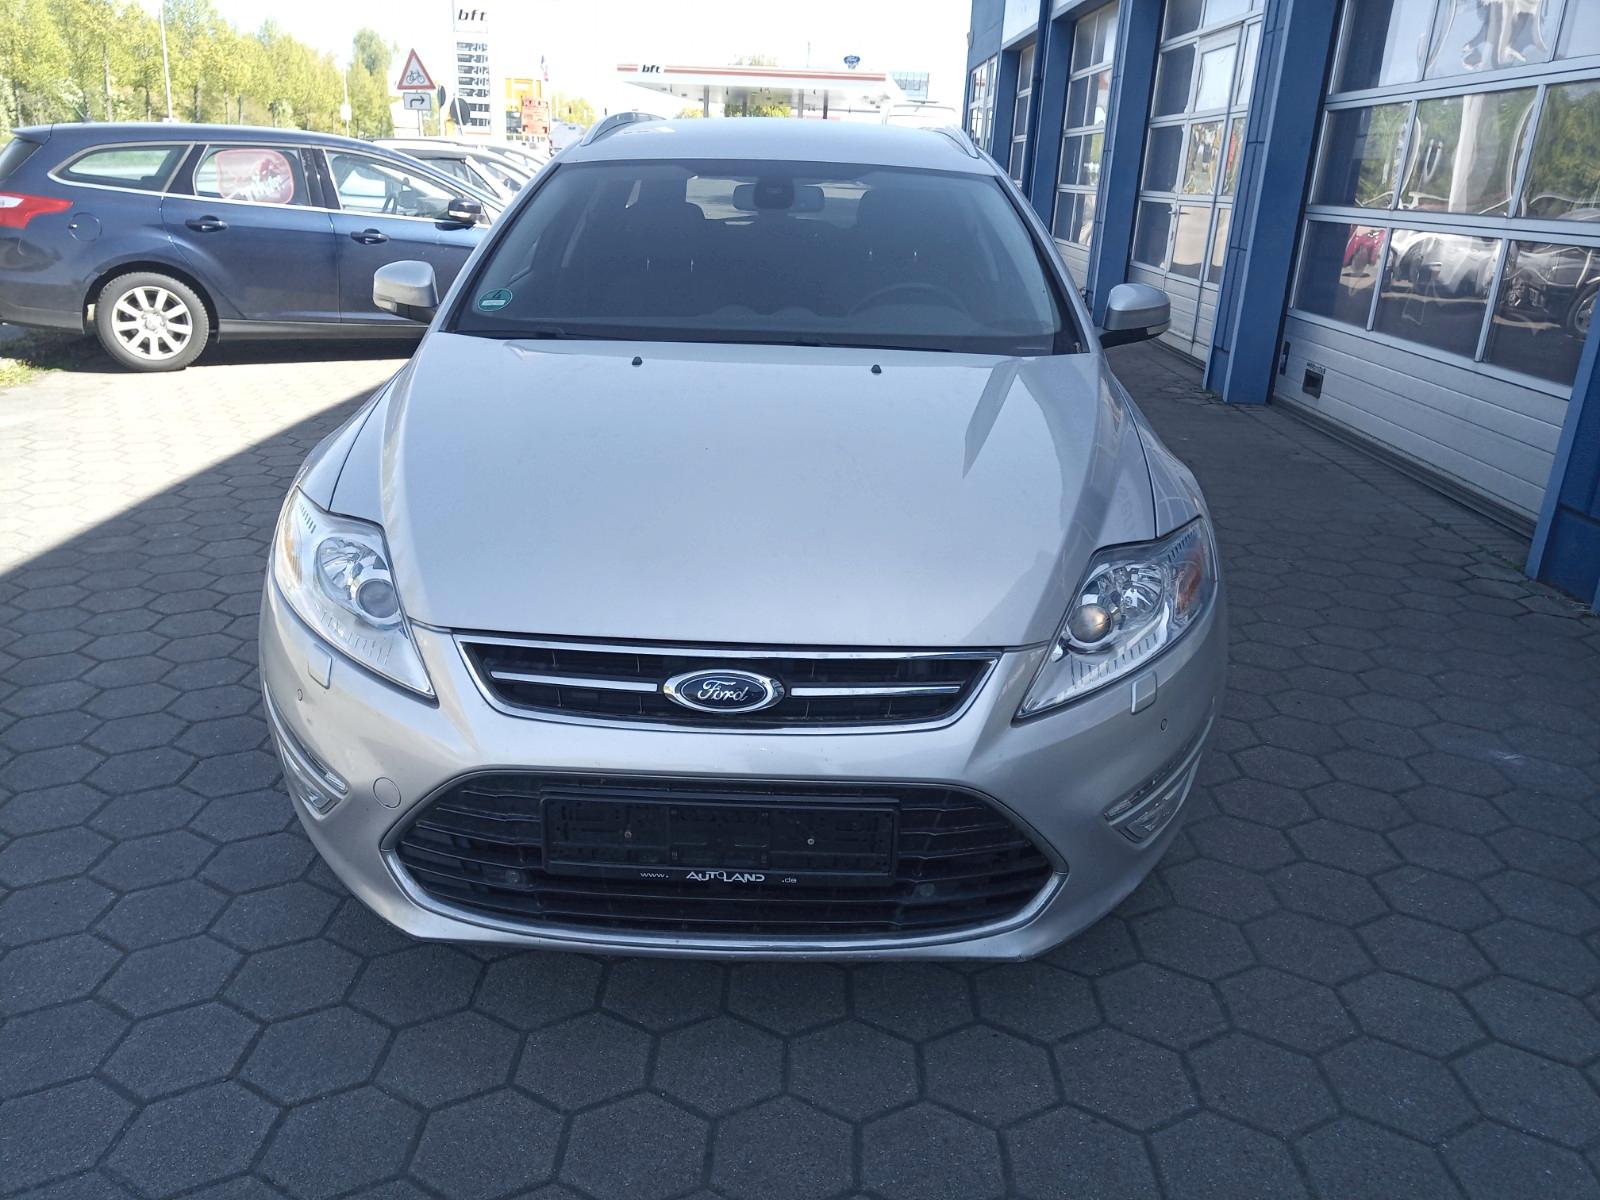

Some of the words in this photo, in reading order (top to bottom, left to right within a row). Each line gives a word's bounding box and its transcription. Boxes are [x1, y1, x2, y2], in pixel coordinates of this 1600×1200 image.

[458, 9, 487, 21] bft
[642, 64, 661, 73] bft
[697, 680, 749, 701] Ford
[686, 870, 766, 883] AUTOLAND
[781, 876, 798, 884] .de
